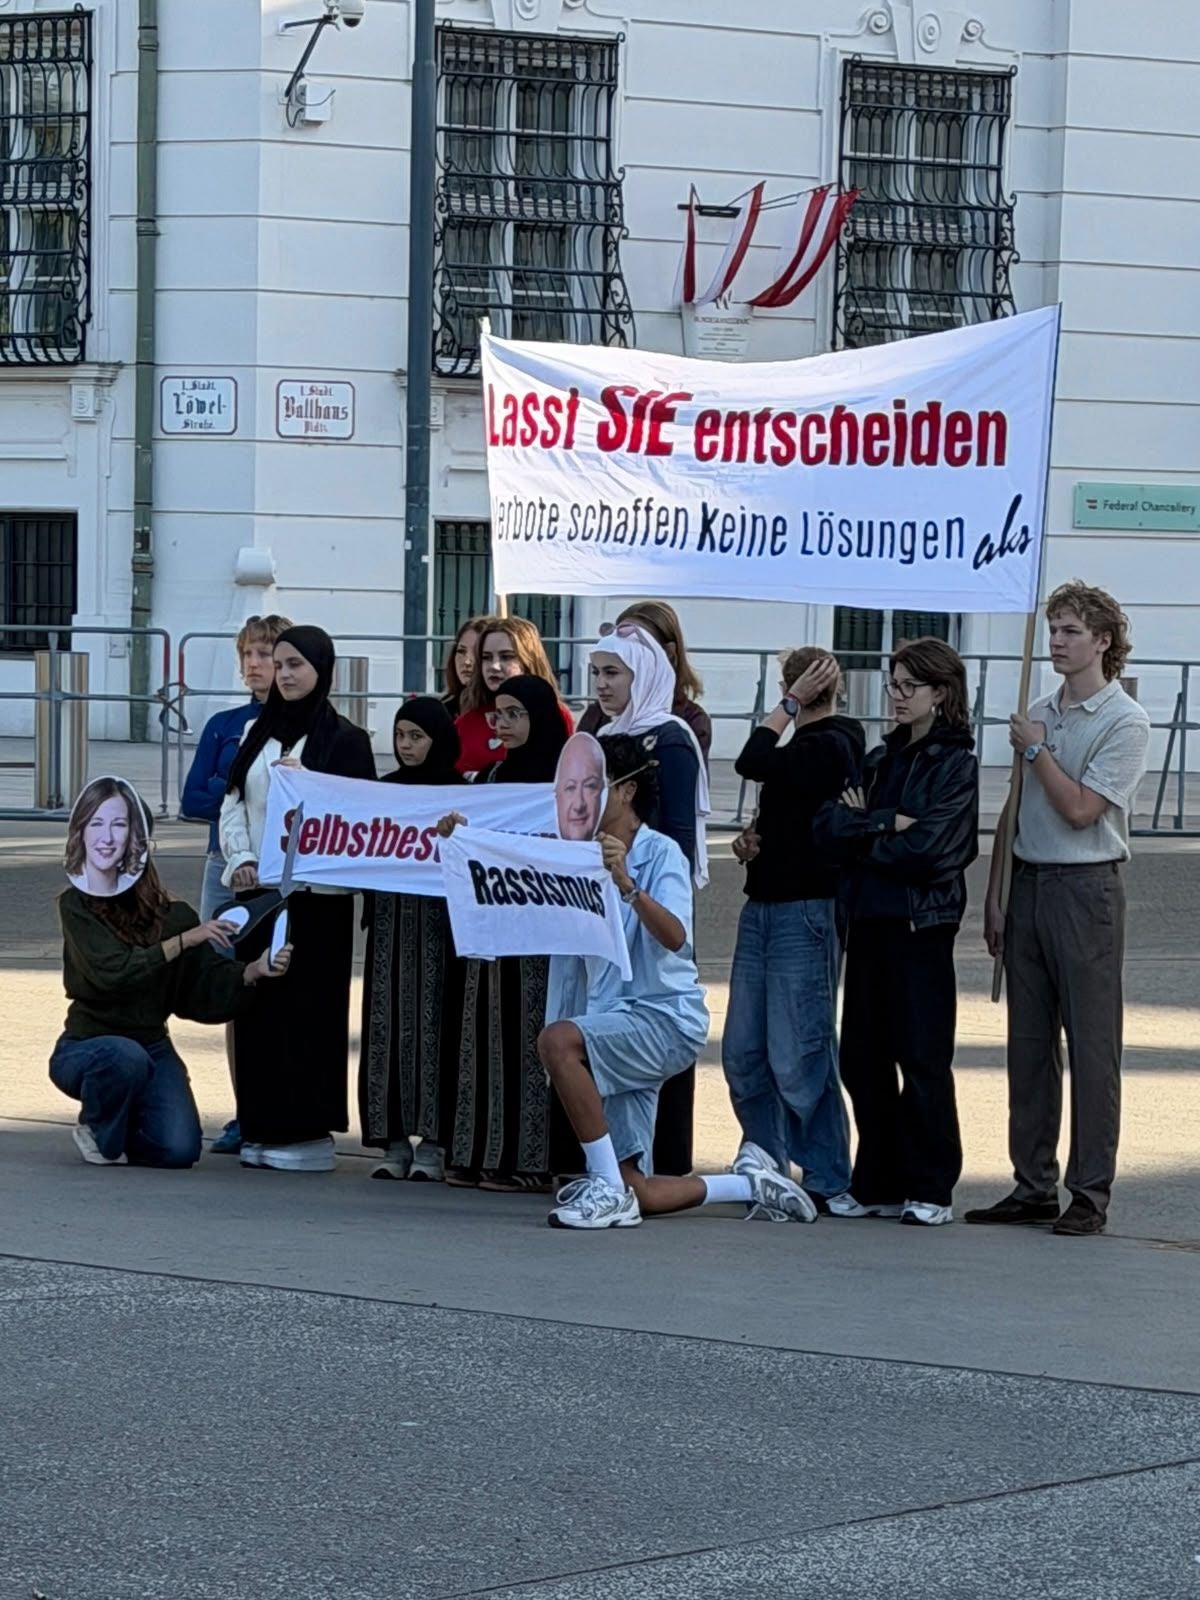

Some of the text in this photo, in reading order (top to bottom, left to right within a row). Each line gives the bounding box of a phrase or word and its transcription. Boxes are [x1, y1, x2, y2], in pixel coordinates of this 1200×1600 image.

[283, 395, 349, 421] Ballhaus
[488, 383, 1008, 467] Lasst SIE entscheiden
[495, 495, 560, 542] erbote
[567, 497, 690, 551] schaffen
[801, 509, 965, 564] Lösungen
[1103, 499, 1195, 515] Federal Chancellery
[467, 859, 606, 919] Rassismus
